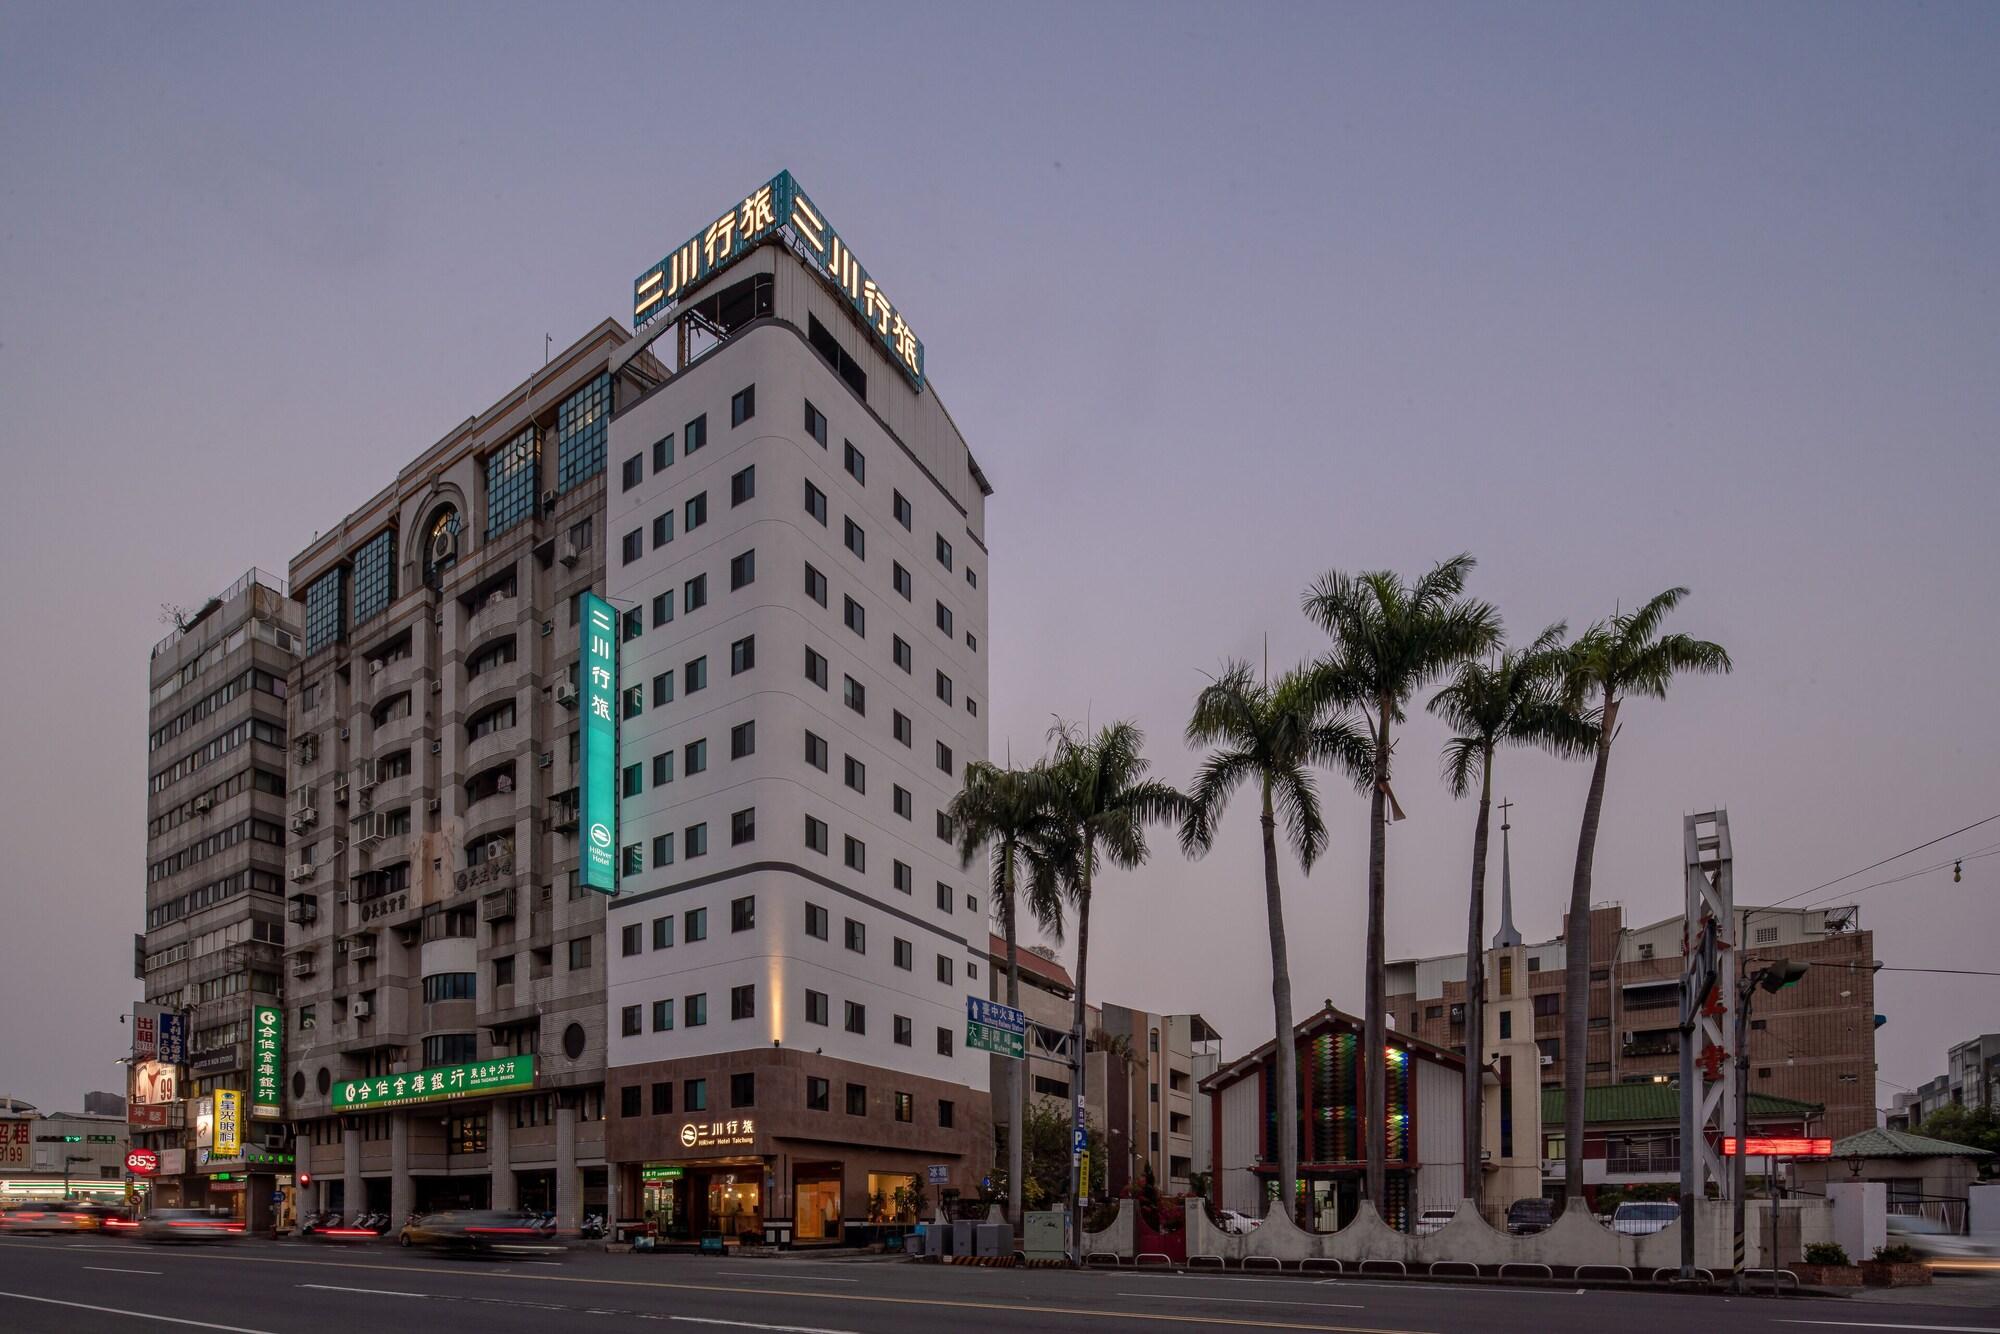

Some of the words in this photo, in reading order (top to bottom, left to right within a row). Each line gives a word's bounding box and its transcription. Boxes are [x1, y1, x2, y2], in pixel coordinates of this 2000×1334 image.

[635, 185, 775, 314] 二川行旅
[792, 196, 919, 375] 二川行旅
[592, 610, 611, 721] 二川行旅
[590, 846, 612, 859] HiRiver
[593, 855, 609, 866] Hotel
[137, 1017, 153, 1042] 出租
[969, 1024, 989, 1041] 大里
[257, 1026, 277, 1100] 合作金庫銀行
[358, 1069, 465, 1100] 合作金庫銀行
[470, 1062, 515, 1079] 東台中分行
[383, 1096, 429, 1106] COOPERATIVE
[220, 1100, 235, 1143] 星光眼科
[698, 1120, 755, 1136] 二川行旅
[717, 1137, 731, 1145] Hotel
[732, 1136, 754, 1145] Taichung
[1075, 1131, 1082, 1145] P
